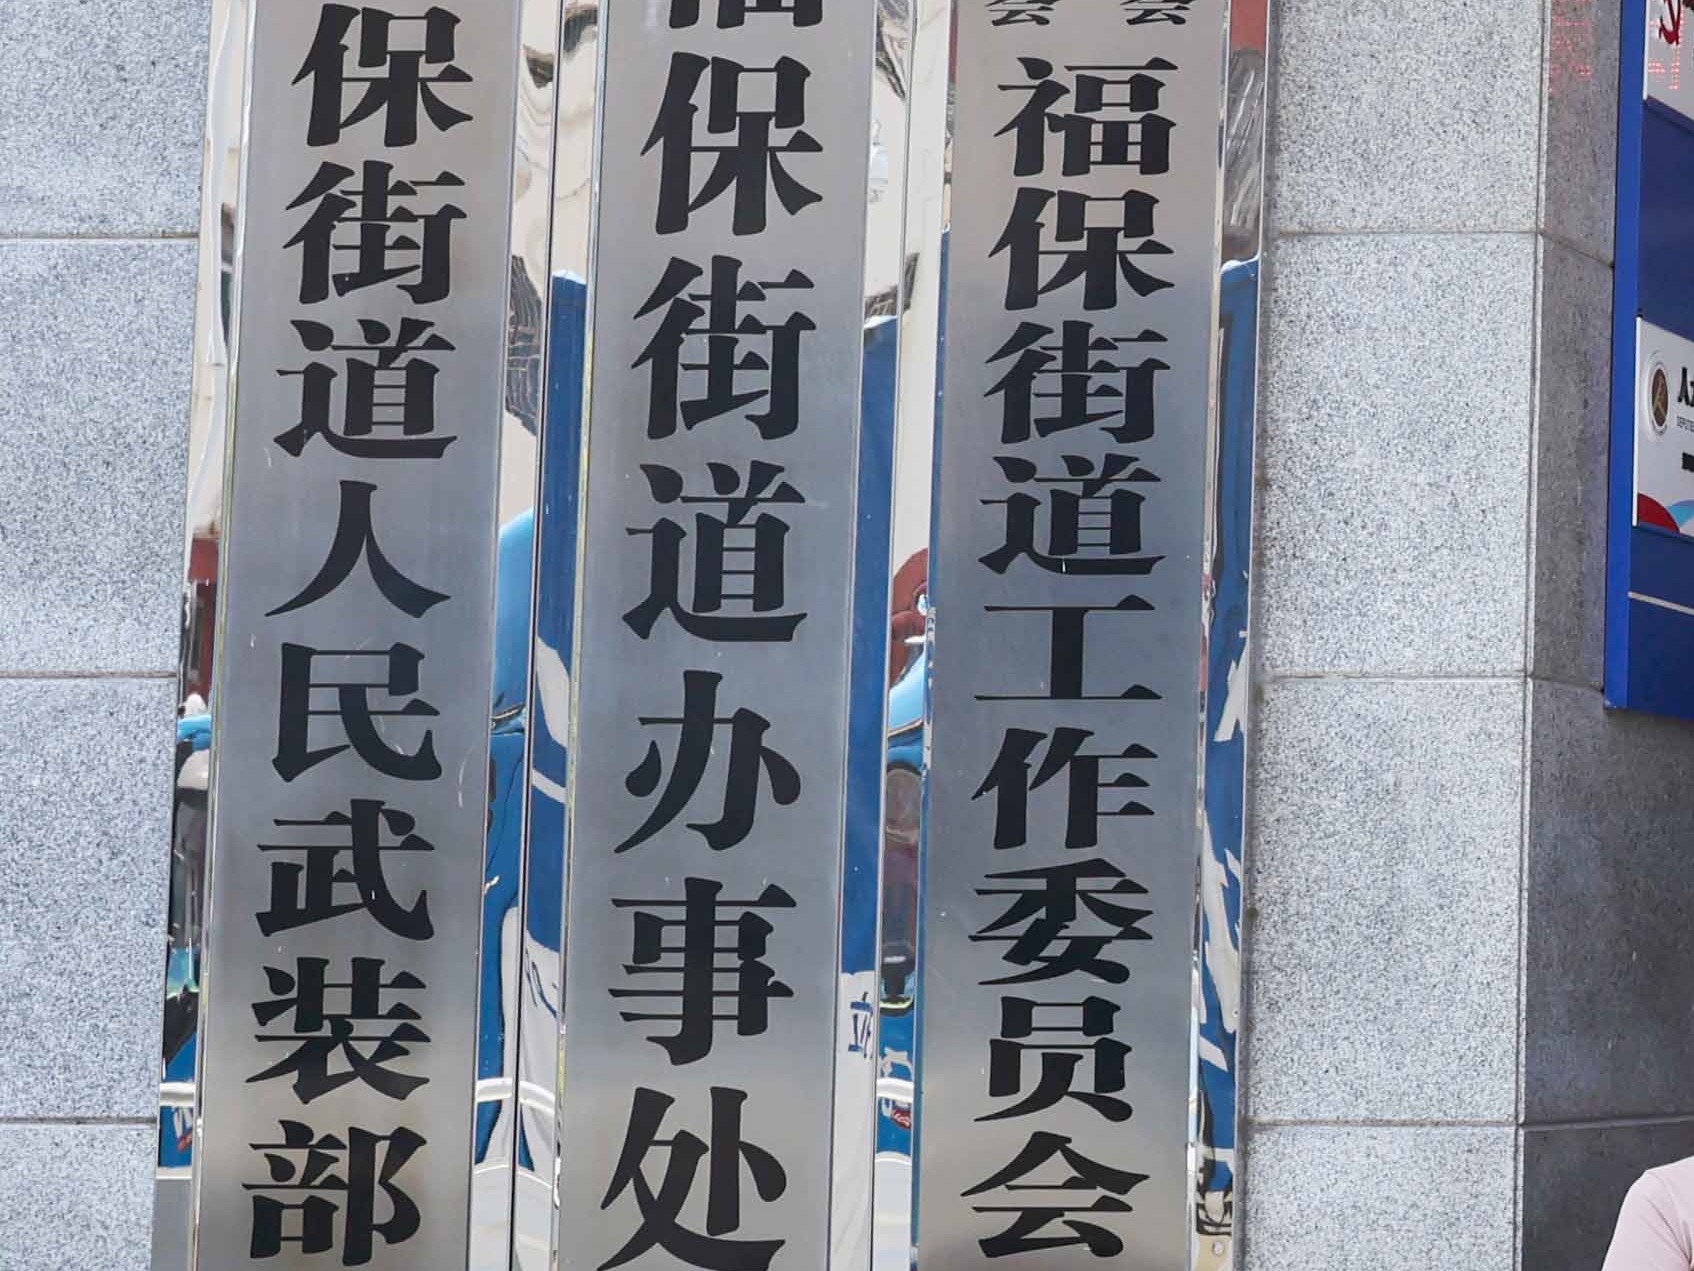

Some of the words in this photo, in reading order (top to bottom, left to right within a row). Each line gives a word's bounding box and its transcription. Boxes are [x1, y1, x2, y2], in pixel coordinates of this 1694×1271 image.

[961, 57, 1178, 1259] 福保街道工作委员会
